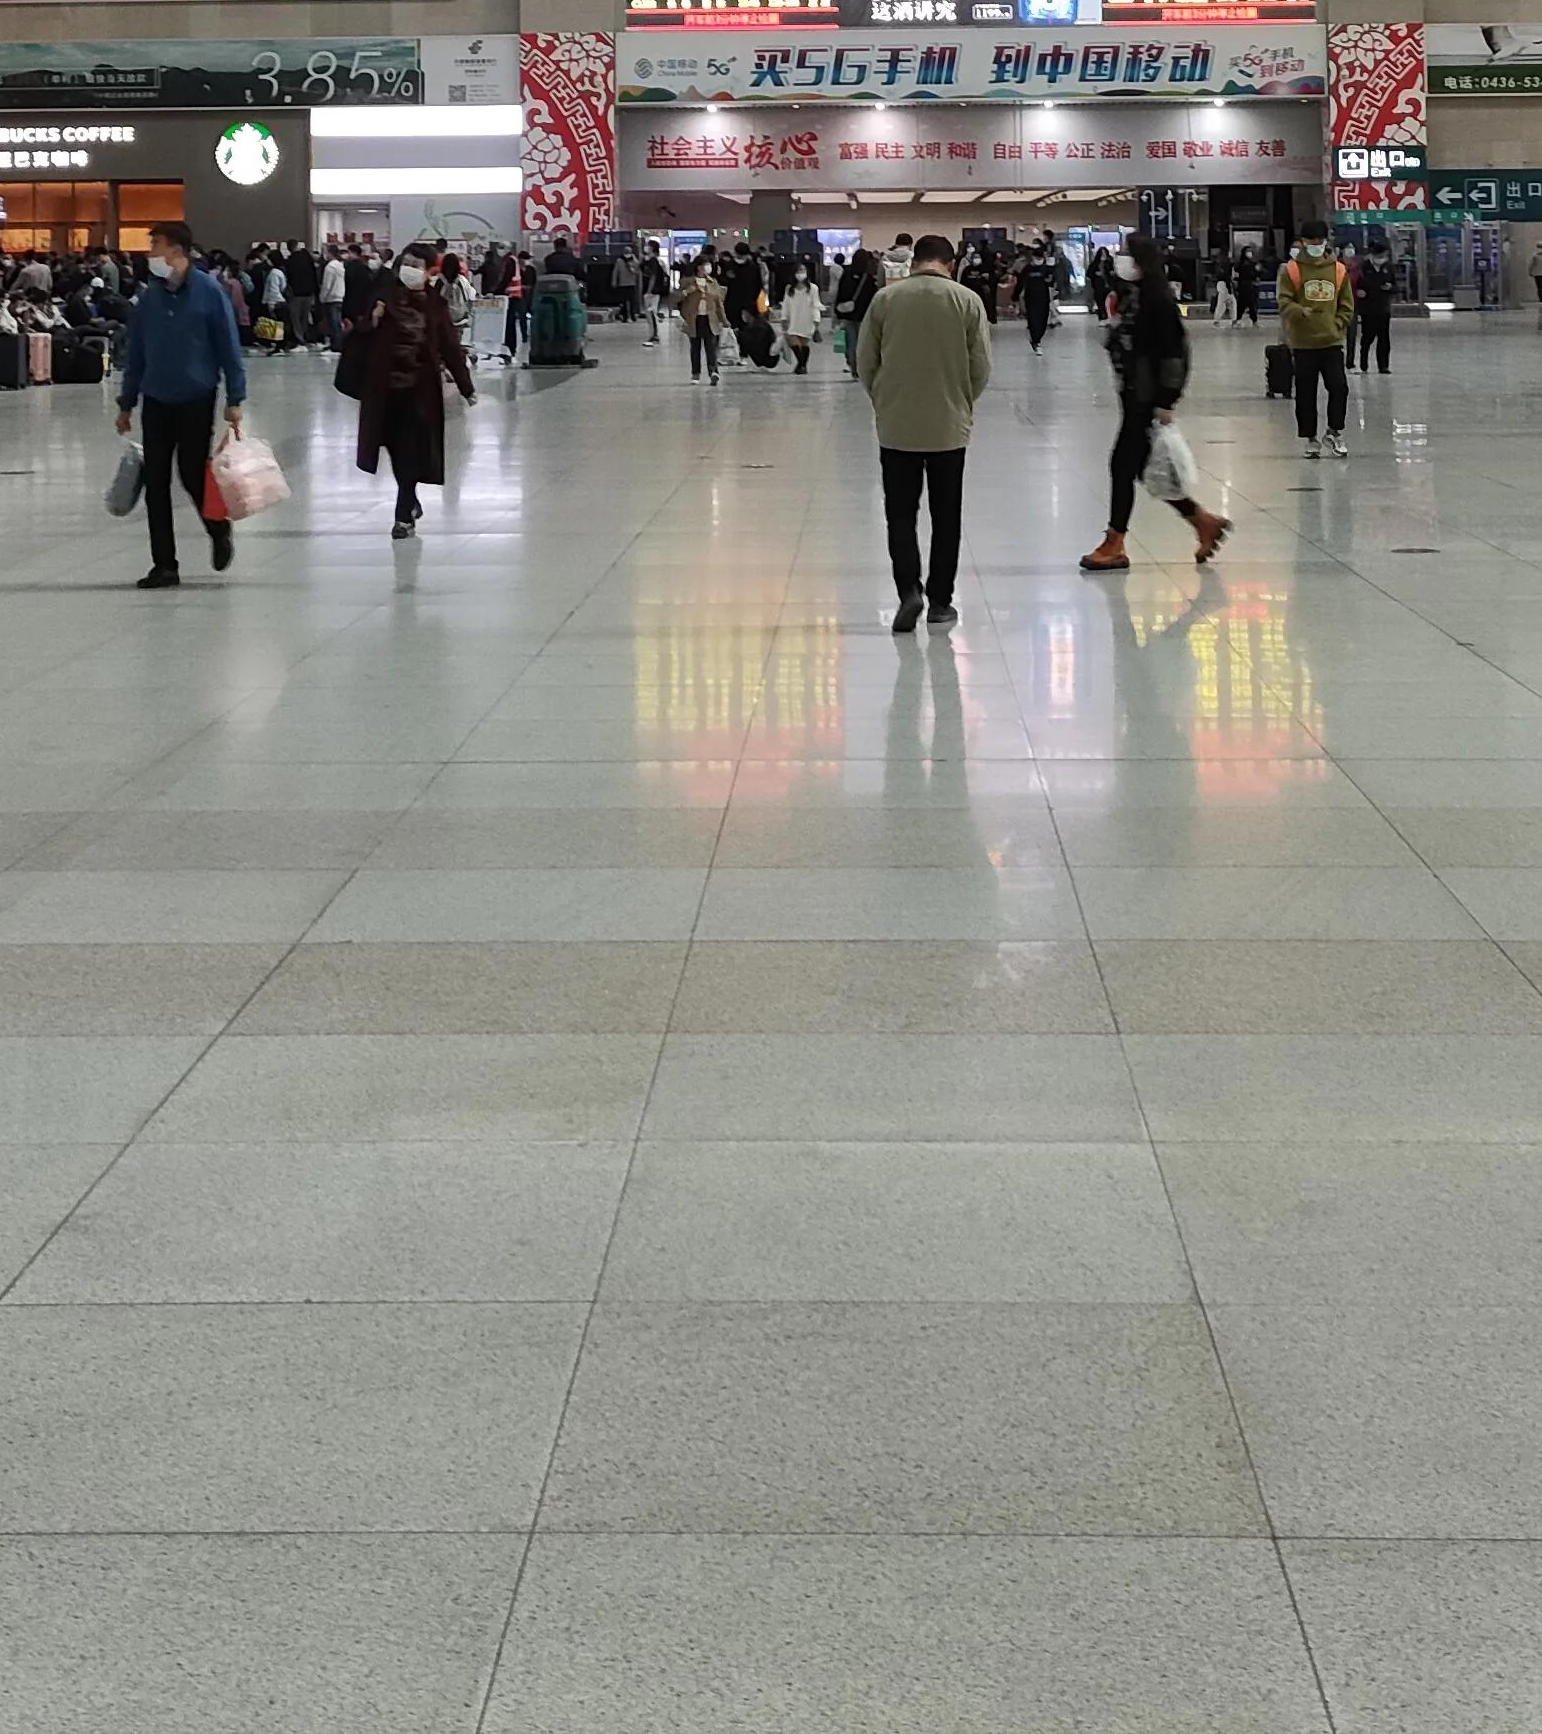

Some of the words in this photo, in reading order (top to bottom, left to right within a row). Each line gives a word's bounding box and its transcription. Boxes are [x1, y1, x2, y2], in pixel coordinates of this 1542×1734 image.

[870, 1, 957, 21] 这酒讲究
[749, 44, 961, 87] 买5G手机
[988, 42, 1214, 84] 到中国移动
[62, 126, 136, 143] COFFEE
[646, 135, 738, 158] 社会主义
[743, 130, 819, 170] 核心
[837, 141, 869, 159] 富强
[874, 141, 905, 159] 民主
[910, 141, 941, 159] 文明
[946, 141, 977, 159] 和谐
[992, 141, 1022, 159] 自由
[1028, 141, 1059, 159] 平等
[1065, 141, 1095, 159] 公正
[1100, 141, 1132, 159] 法治
[1145, 141, 1178, 159] 爱国
[1182, 141, 1214, 159] 敬业
[1218, 141, 1250, 159] 诚信
[1254, 141, 1287, 159] 友善
[1370, 149, 1405, 167] 出口
[1506, 181, 1542, 198] 出口
[1506, 200, 1526, 210] Exit
